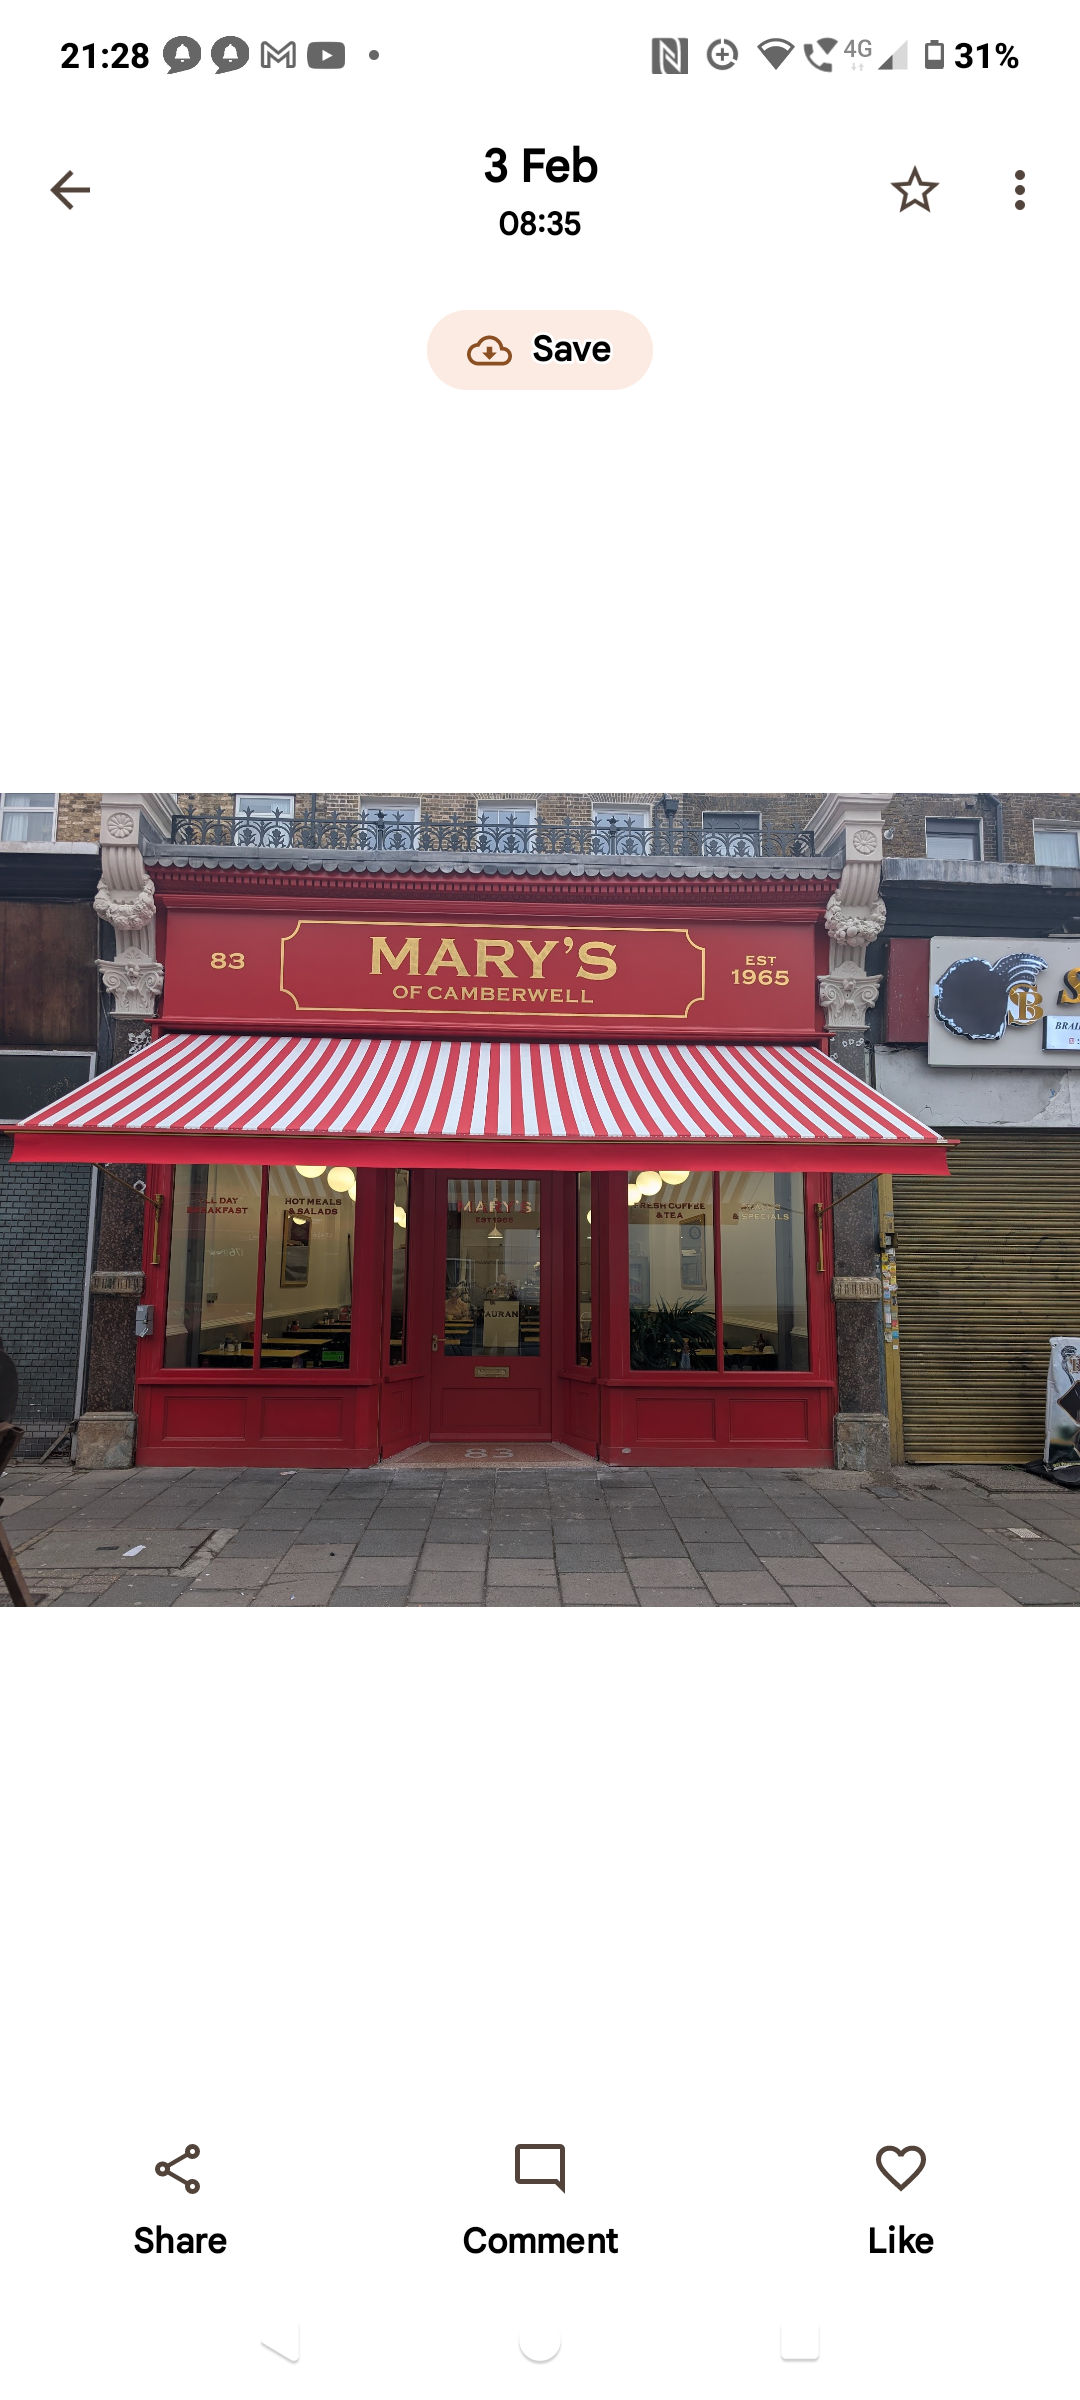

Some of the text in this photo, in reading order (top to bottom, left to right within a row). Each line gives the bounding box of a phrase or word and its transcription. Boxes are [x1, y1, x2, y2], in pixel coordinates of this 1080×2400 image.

[210, 952, 245, 970] 83
[369, 936, 618, 981] MARY'S
[745, 955, 777, 966] EST
[731, 968, 790, 986] 1965
[392, 985, 594, 1004] OF CAMBERWELL
[1055, 1021, 1080, 1030] BRAI
[219, 1197, 239, 1205] DAY
[284, 1197, 342, 1206] HOT MEALS
[457, 1199, 532, 1213] MARY'S
[633, 1202, 706, 1210] FRESH COFFEE
[295, 1207, 338, 1215] SALADS
[664, 1211, 683, 1219] TEA
[741, 1213, 790, 1221] SPECIALS
[484, 1310, 519, 1318] AURAN
[464, 1447, 515, 1459] 83
